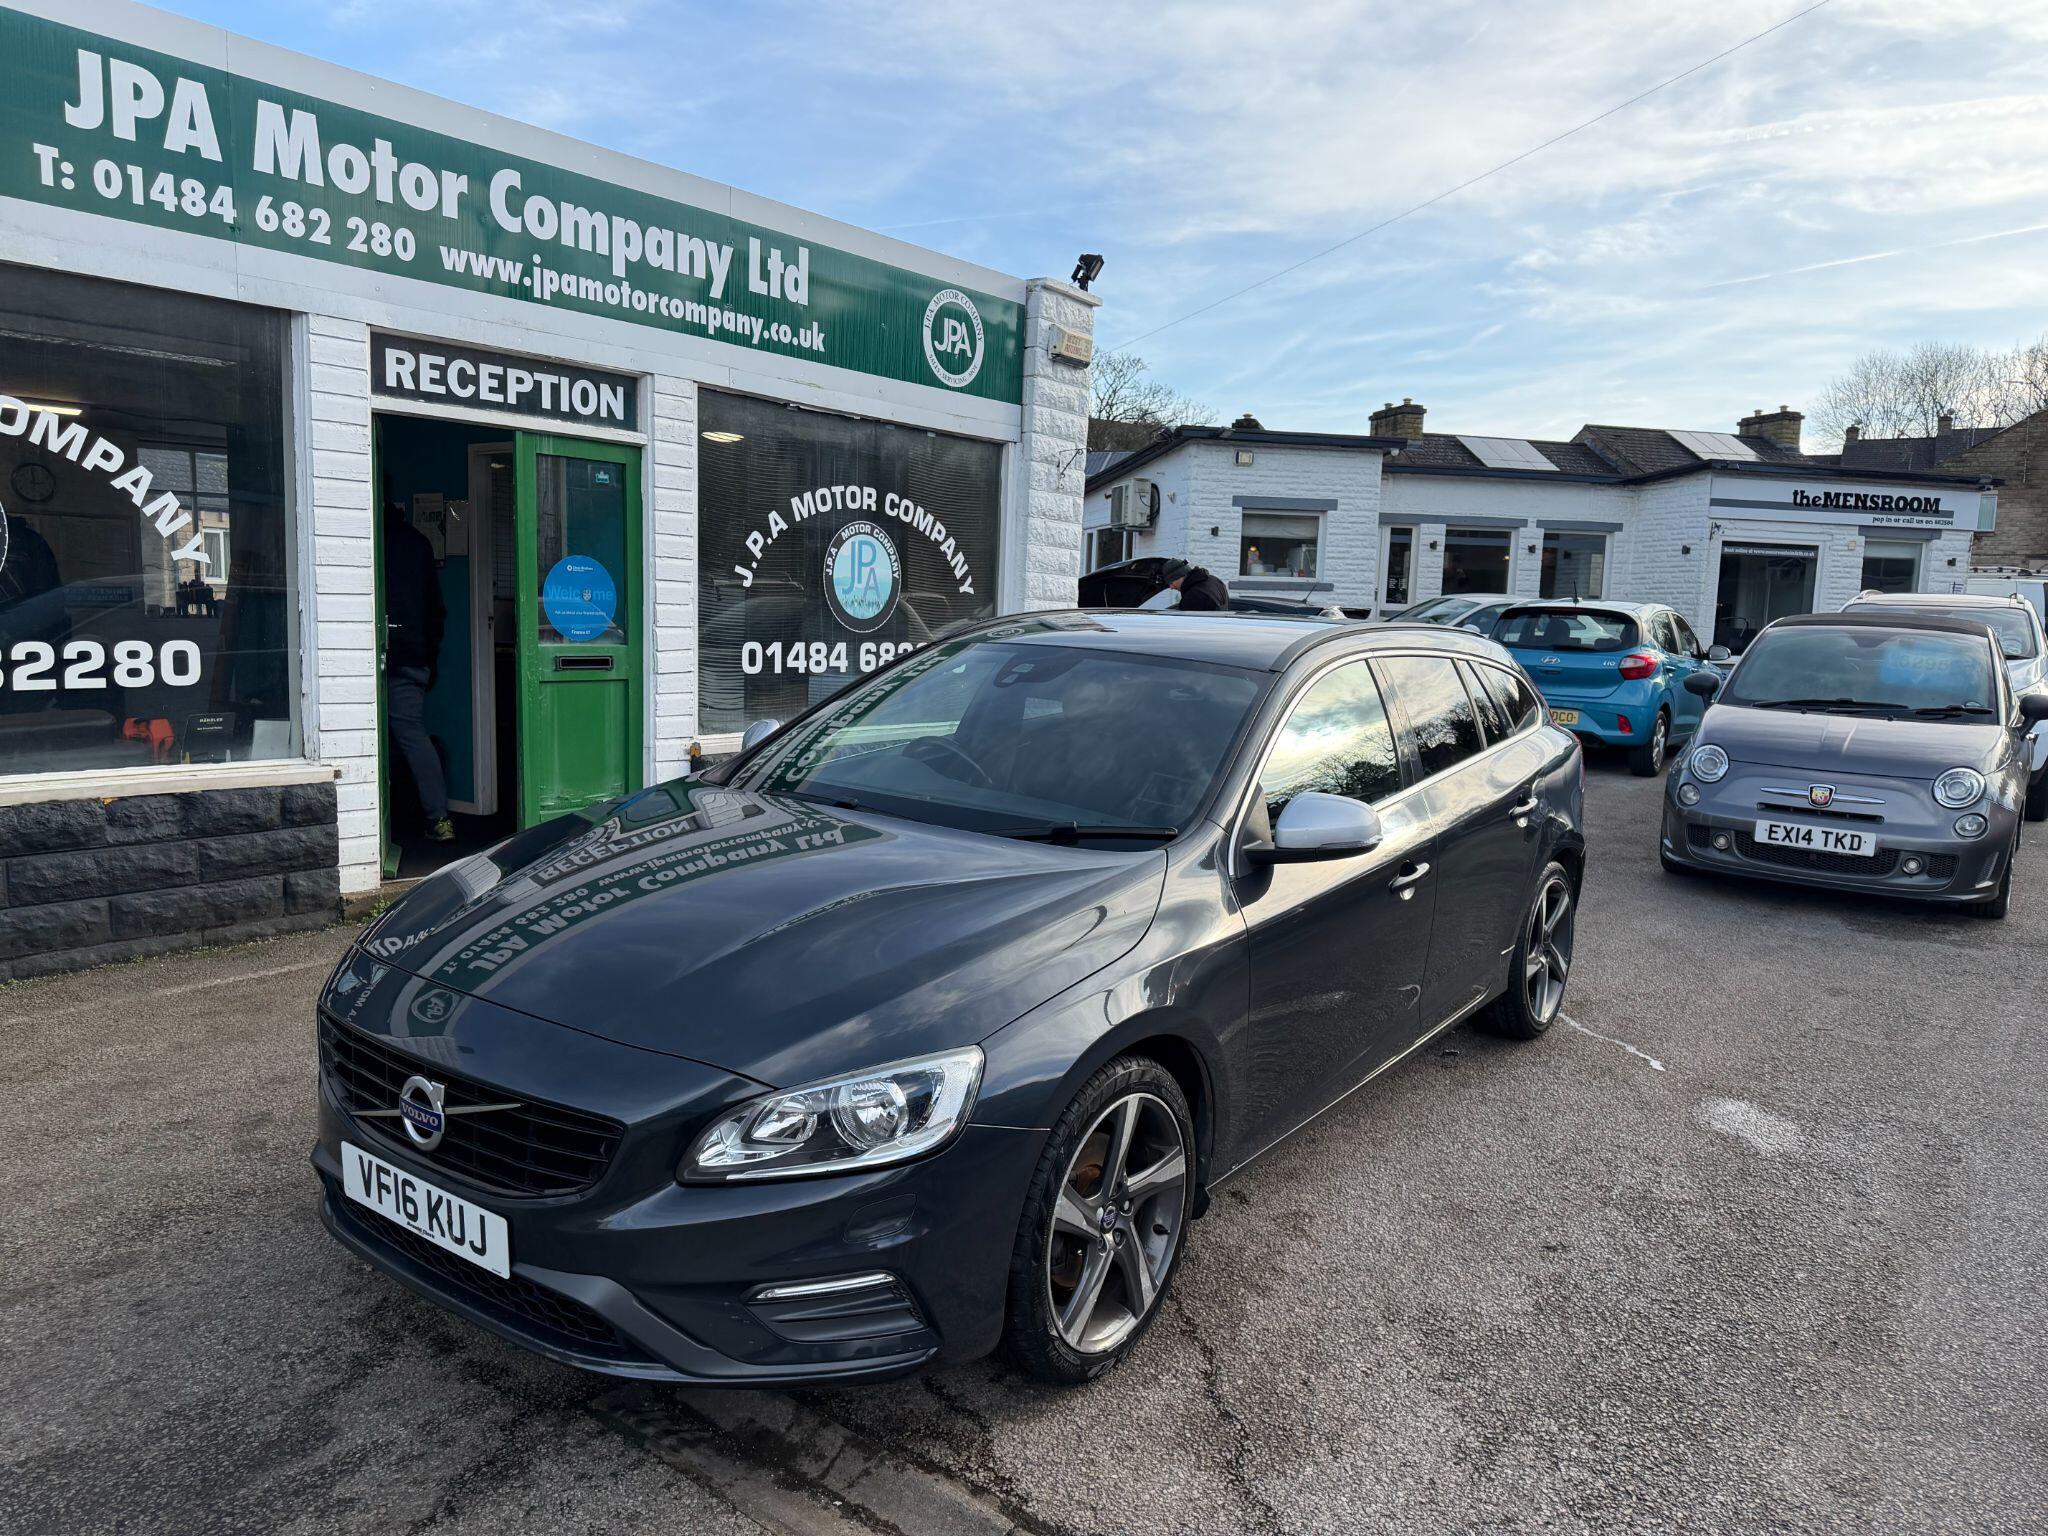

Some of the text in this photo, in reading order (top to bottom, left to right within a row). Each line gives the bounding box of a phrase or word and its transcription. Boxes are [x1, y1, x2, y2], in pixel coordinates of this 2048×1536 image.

[64, 49, 809, 305] JPA Motor Company Ltd
[34, 143, 825, 352] T: 01484 682 280 www.jpamotorcompany.co.uk
[933, 290, 960, 307] MOTOR
[960, 297, 983, 342] COMPANY
[933, 317, 972, 358] JPA
[384, 347, 625, 420] RECEPTION
[734, 485, 975, 596] J.P.A MOTOR COMPANY
[826, 523, 899, 579] J.P.A MOTOR COMPANY
[841, 540, 881, 600] JPA
[741, 641, 848, 675] 01484
[1767, 824, 1862, 851] EX14 TKD
[401, 1101, 439, 1127] VOLVO
[358, 1154, 487, 1256] VF16 KUJ
